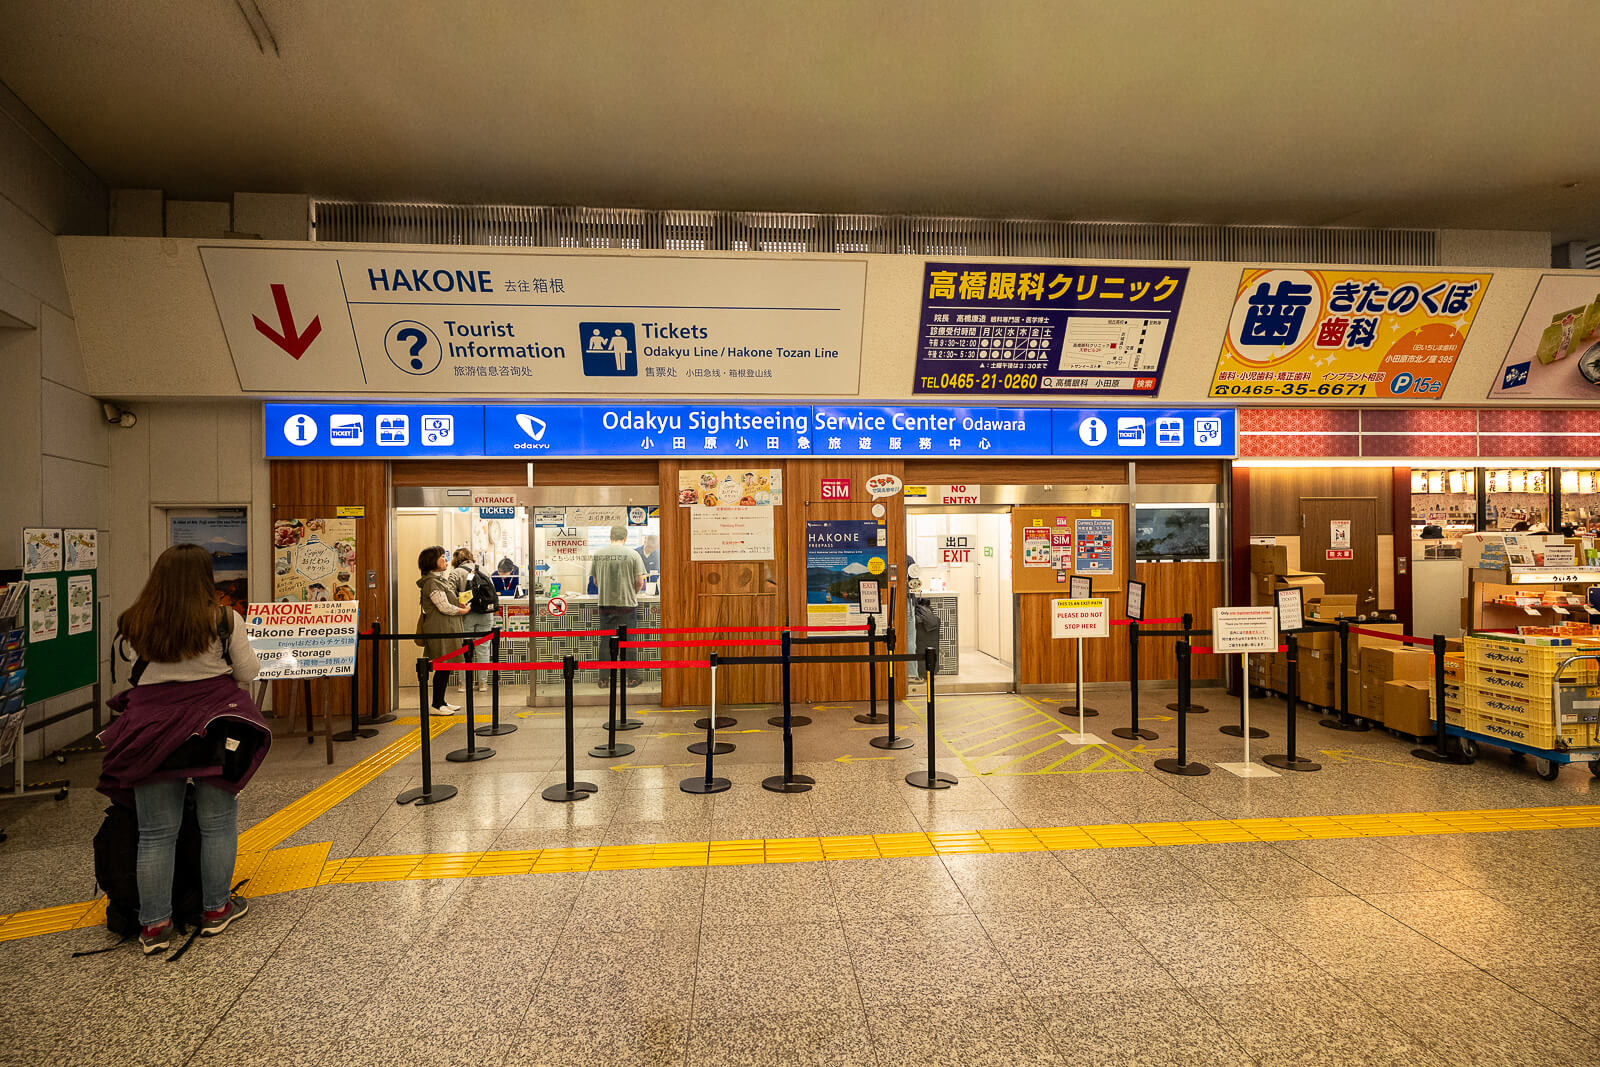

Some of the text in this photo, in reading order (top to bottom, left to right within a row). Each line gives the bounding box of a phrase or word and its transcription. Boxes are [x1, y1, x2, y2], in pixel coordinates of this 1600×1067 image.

[368, 268, 494, 293] HAKONE
[504, 278, 566, 294] 去往箱根
[928, 270, 1180, 302] 高橋眼科クリニック
[1329, 282, 1478, 313] きたのくぼ
[1240, 280, 1312, 346] 歯
[444, 320, 514, 338] Tourist
[642, 322, 708, 340] Tickets
[930, 328, 1052, 337] 診療受付時間 月 火 水 木 金 土
[1316, 317, 1378, 348] 歯科
[449, 342, 566, 358] Information
[644, 346, 838, 360] Odakyu Line / Hakone Tozan Line
[1438, 356, 1454, 364] 395
[454, 366, 533, 377] 旅游信息咨询处
[646, 366, 678, 378] 售票处
[1322, 372, 1386, 382] インプラント相談
[1056, 379, 1088, 387] 高橋眼科
[1096, 380, 1120, 388] 小田原
[1414, 378, 1442, 393] 15台
[1232, 384, 1367, 396] 0465-35-6671
[602, 410, 1026, 434] Odakyu Sightseeing Service Center Odawara
[332, 430, 352, 438] TICKET
[870, 477, 894, 488] こちら
[822, 485, 848, 498] SIM
[557, 527, 576, 537] 入口
[808, 533, 859, 542] HAKONE
[946, 536, 968, 547] 出口
[1053, 536, 1070, 544] SIM
[944, 550, 970, 562] EXIT
[248, 604, 312, 616] HAKONE
[266, 614, 352, 625] INFORMATION
[246, 627, 355, 638] Hakone Freepass
[256, 649, 331, 662] ggag Storage
[257, 669, 282, 678] ency
[284, 667, 328, 677] Exchange
